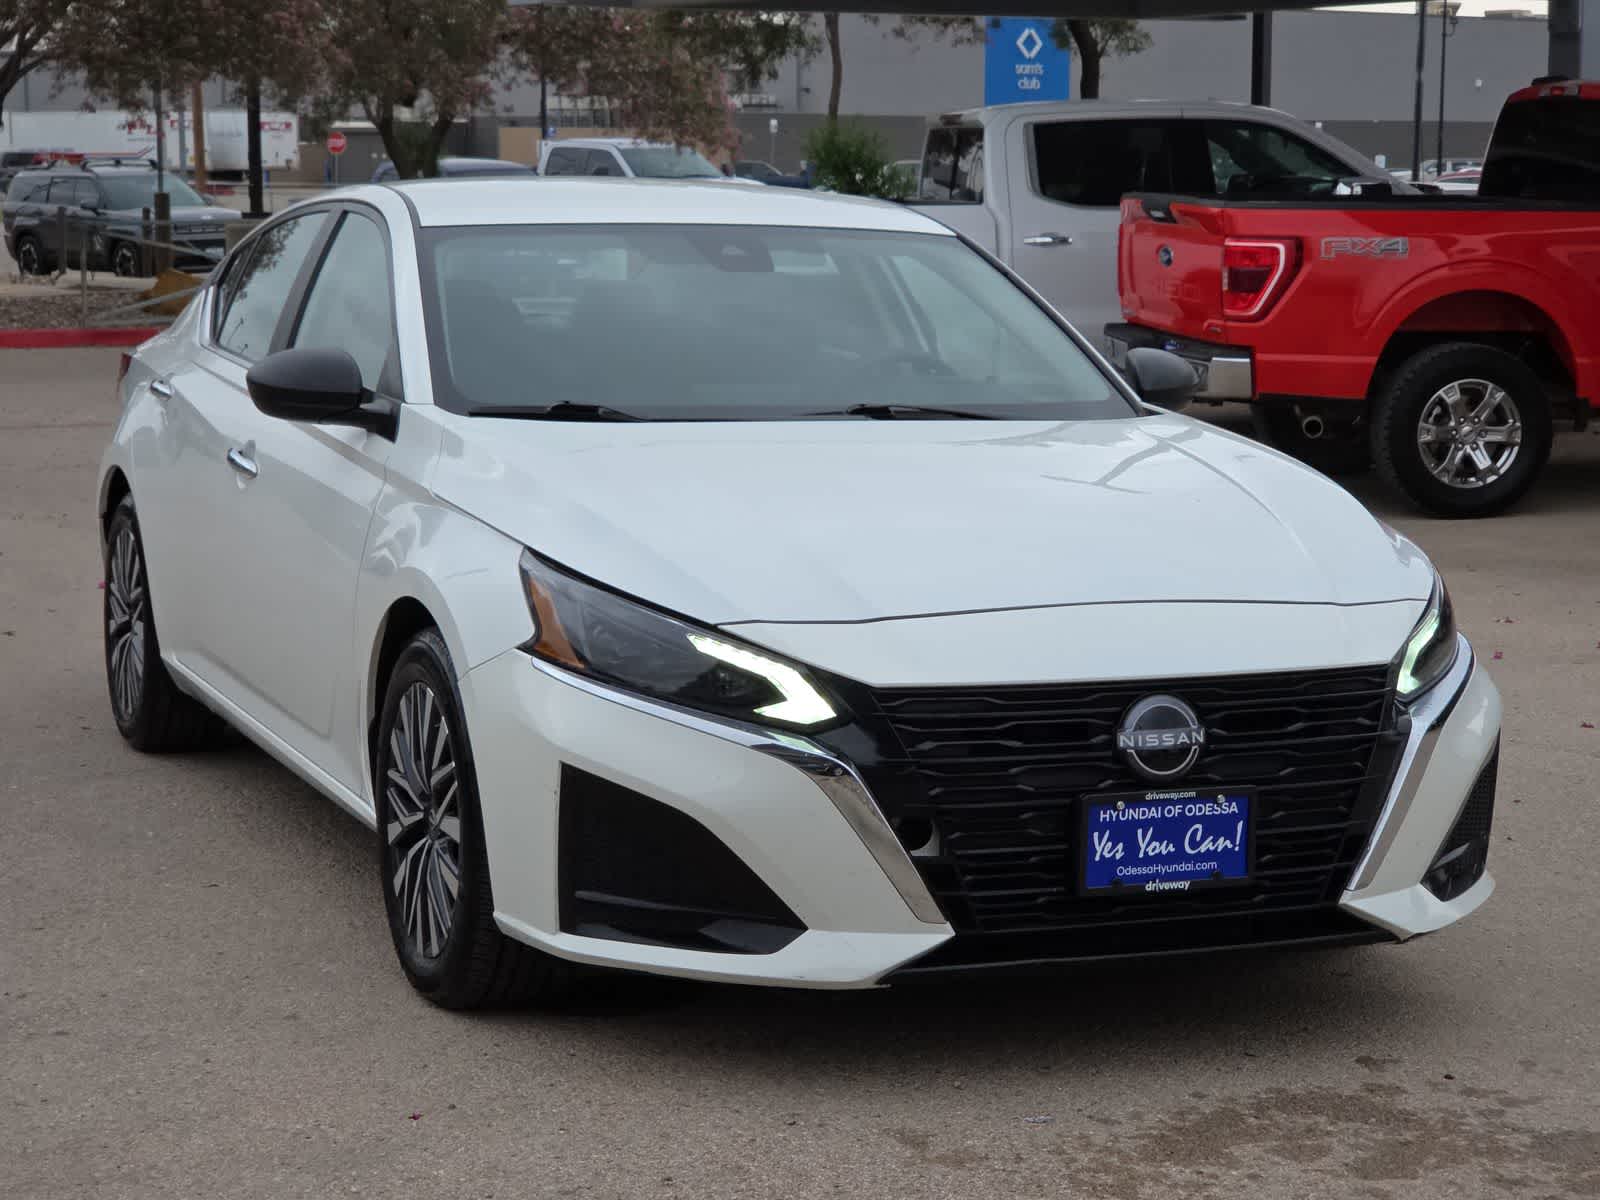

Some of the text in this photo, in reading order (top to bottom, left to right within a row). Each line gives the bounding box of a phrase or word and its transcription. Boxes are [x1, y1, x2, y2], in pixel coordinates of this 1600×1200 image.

[1018, 76, 1040, 89] club
[1320, 236, 1409, 260] FX4
[1119, 729, 1204, 747] NISSAN
[1145, 791, 1196, 801] driveway.com
[1100, 802, 1239, 822] HYUNDAI OF ODESSA
[1093, 820, 1243, 862] Yes You Can!
[1117, 861, 1217, 876] OdessaHyundai.com
[1145, 879, 1191, 892] driveway
